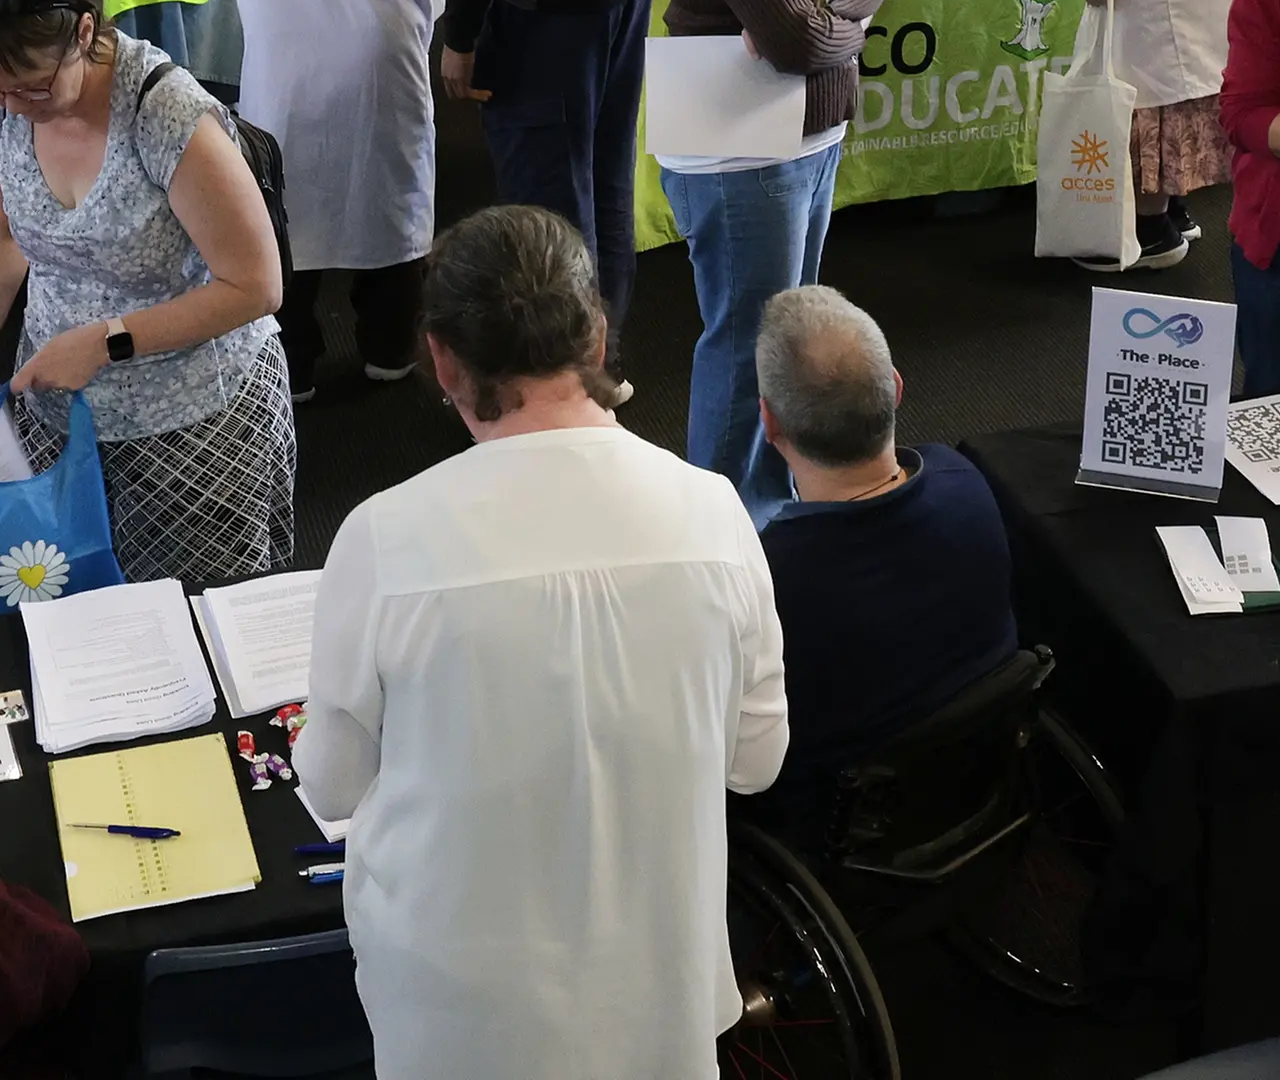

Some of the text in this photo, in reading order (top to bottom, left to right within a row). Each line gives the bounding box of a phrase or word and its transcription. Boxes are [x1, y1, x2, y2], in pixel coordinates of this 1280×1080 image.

[859, 22, 937, 77] CO
[855, 57, 1072, 134] DUCAT
[842, 135, 919, 156] STAINABLE
[1120, 349, 1200, 369] The Place
